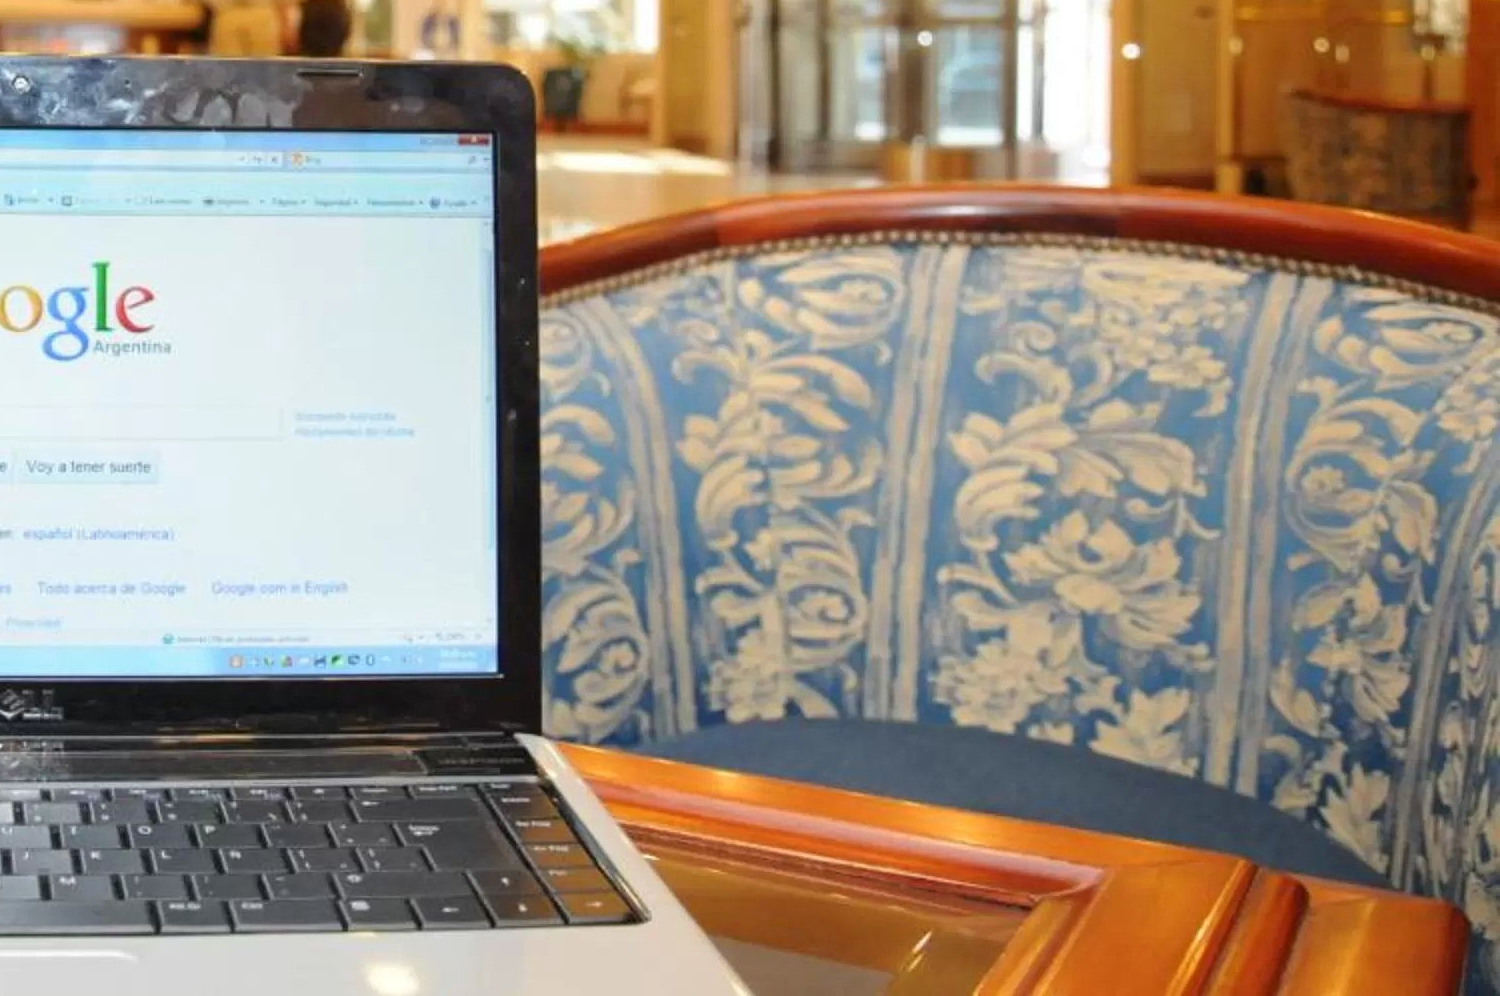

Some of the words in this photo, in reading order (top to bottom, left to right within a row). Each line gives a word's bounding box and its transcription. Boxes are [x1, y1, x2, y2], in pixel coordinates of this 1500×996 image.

[93, 339, 172, 354] Argentina
[25, 459, 53, 475] Voy
[57, 463, 67, 472] a
[137, 825, 152, 835] O
